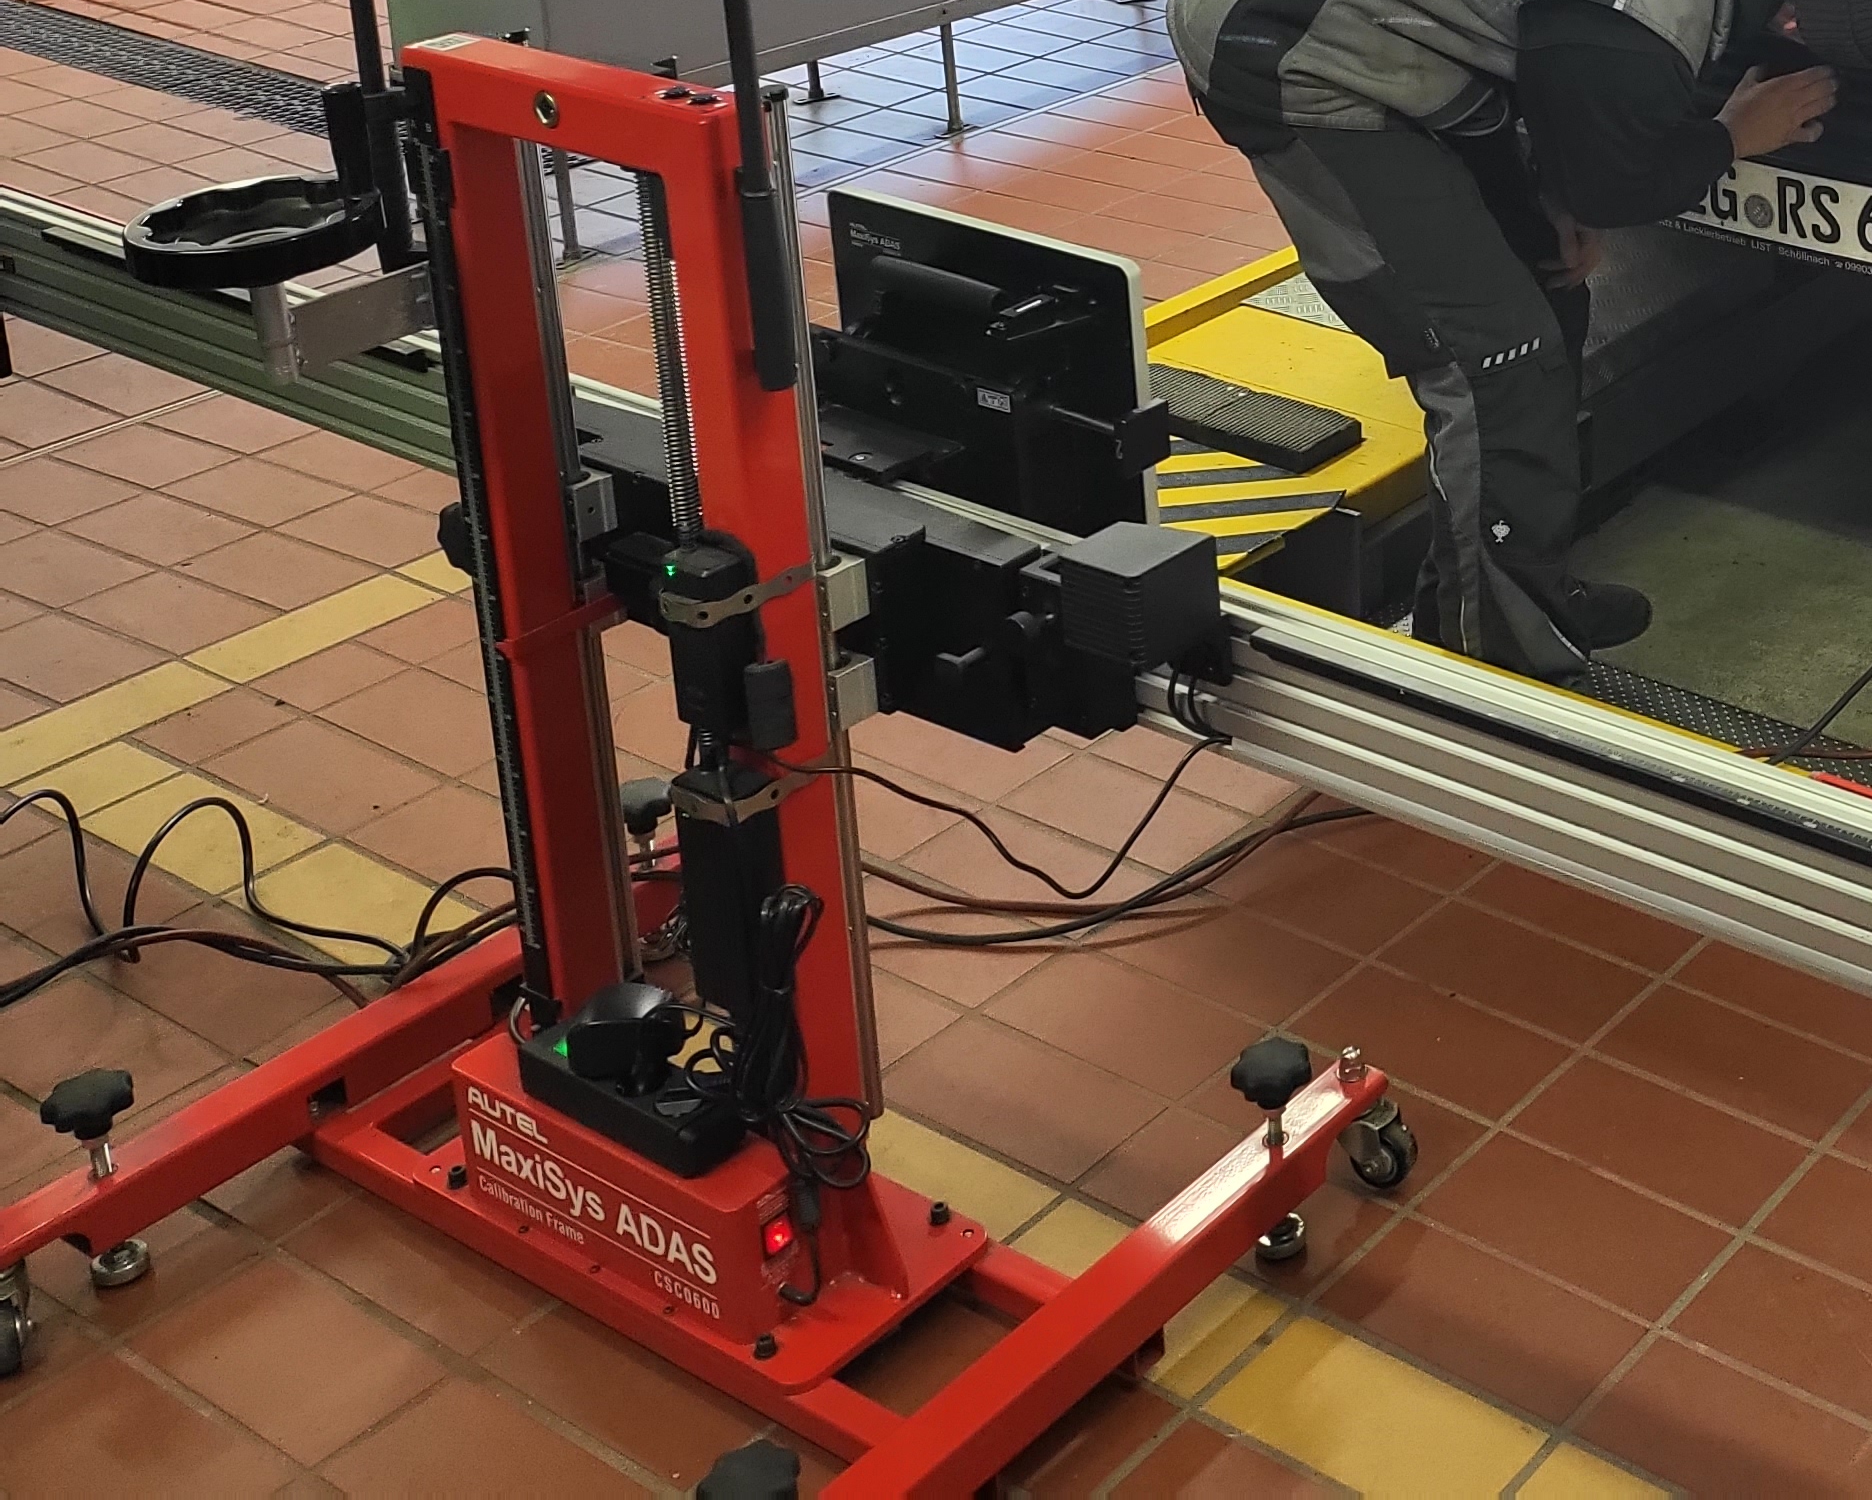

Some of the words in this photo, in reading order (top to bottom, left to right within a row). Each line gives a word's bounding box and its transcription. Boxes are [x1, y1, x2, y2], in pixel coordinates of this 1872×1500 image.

[1776, 175, 1842, 245] RS
[1751, 240, 1771, 253] LIST
[467, 1086, 549, 1145] AUTEL
[471, 1119, 606, 1221] MaxiSys
[616, 1203, 718, 1285] ADAS
[479, 1175, 543, 1225] Calibration
[546, 1211, 584, 1245] Frame
[653, 1270, 720, 1320] CSC0600
